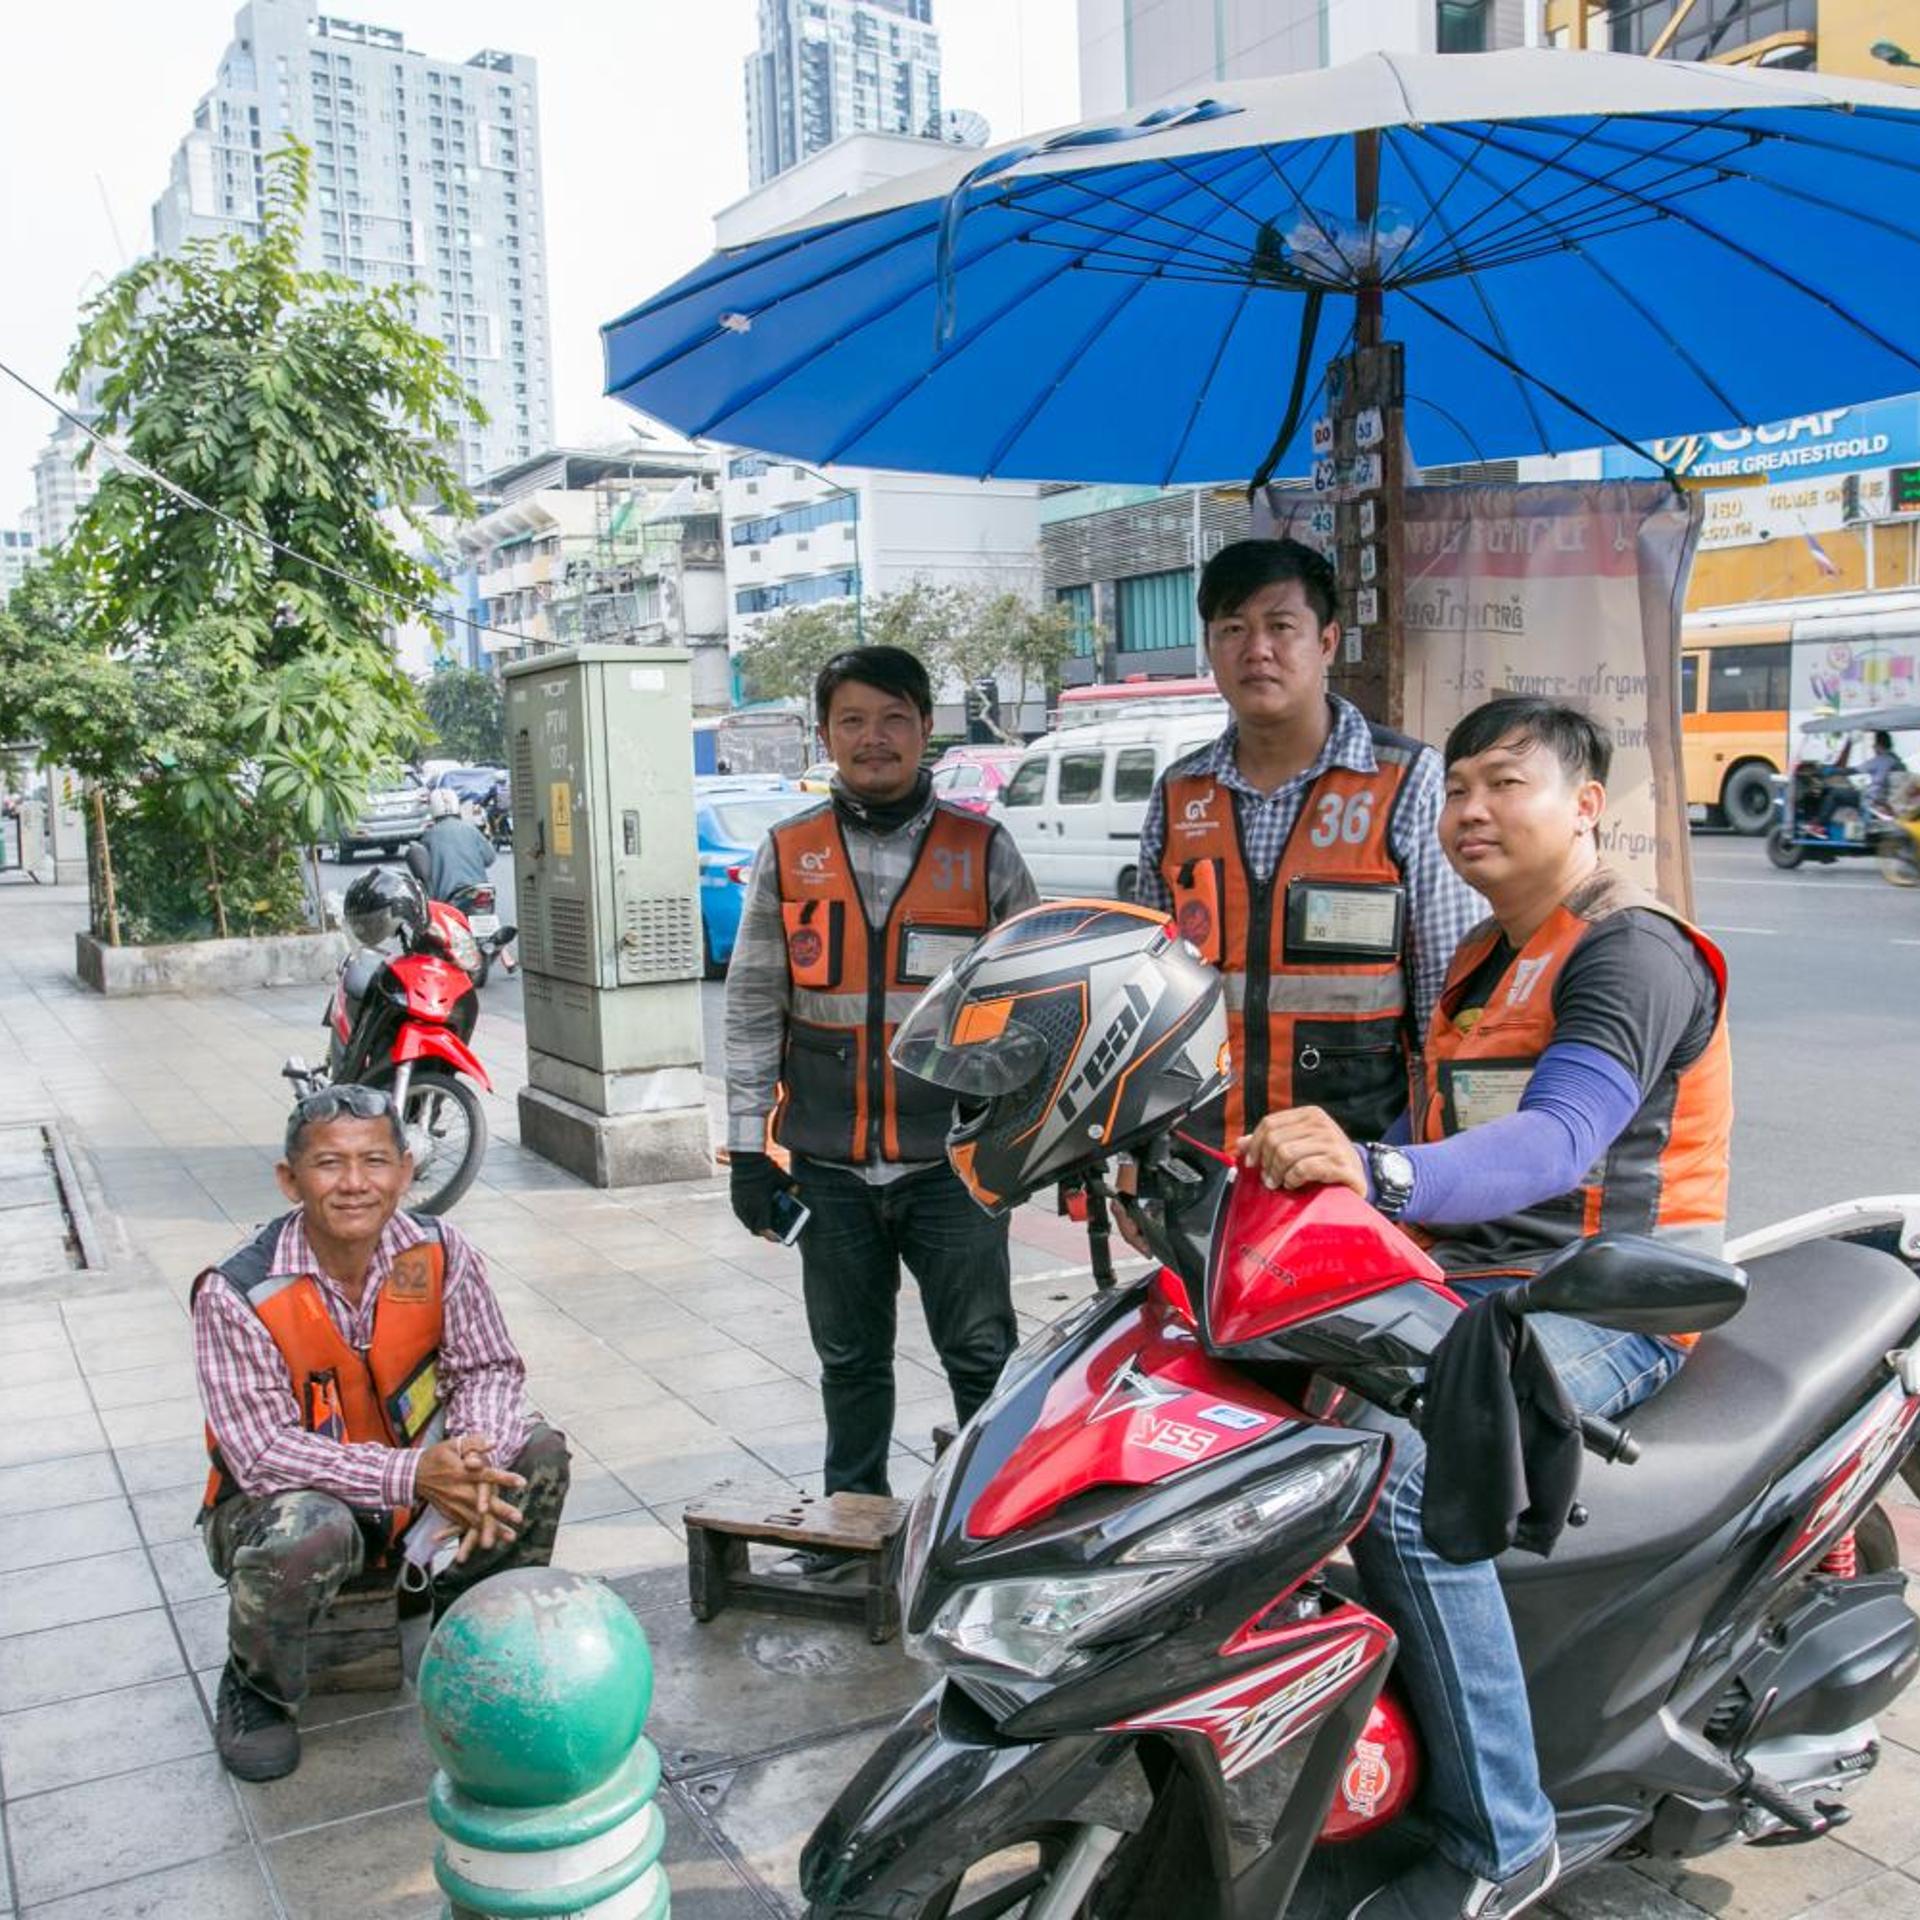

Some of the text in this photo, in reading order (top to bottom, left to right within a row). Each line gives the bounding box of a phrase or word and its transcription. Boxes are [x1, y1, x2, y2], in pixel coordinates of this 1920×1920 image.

[1314, 463, 1336, 492] 62
[1310, 791, 1375, 848] 36
[931, 846, 973, 891] 31
[1057, 983, 1151, 1123] real
[394, 1260, 427, 1289] 62
[1129, 1412, 1219, 1462] YSS
